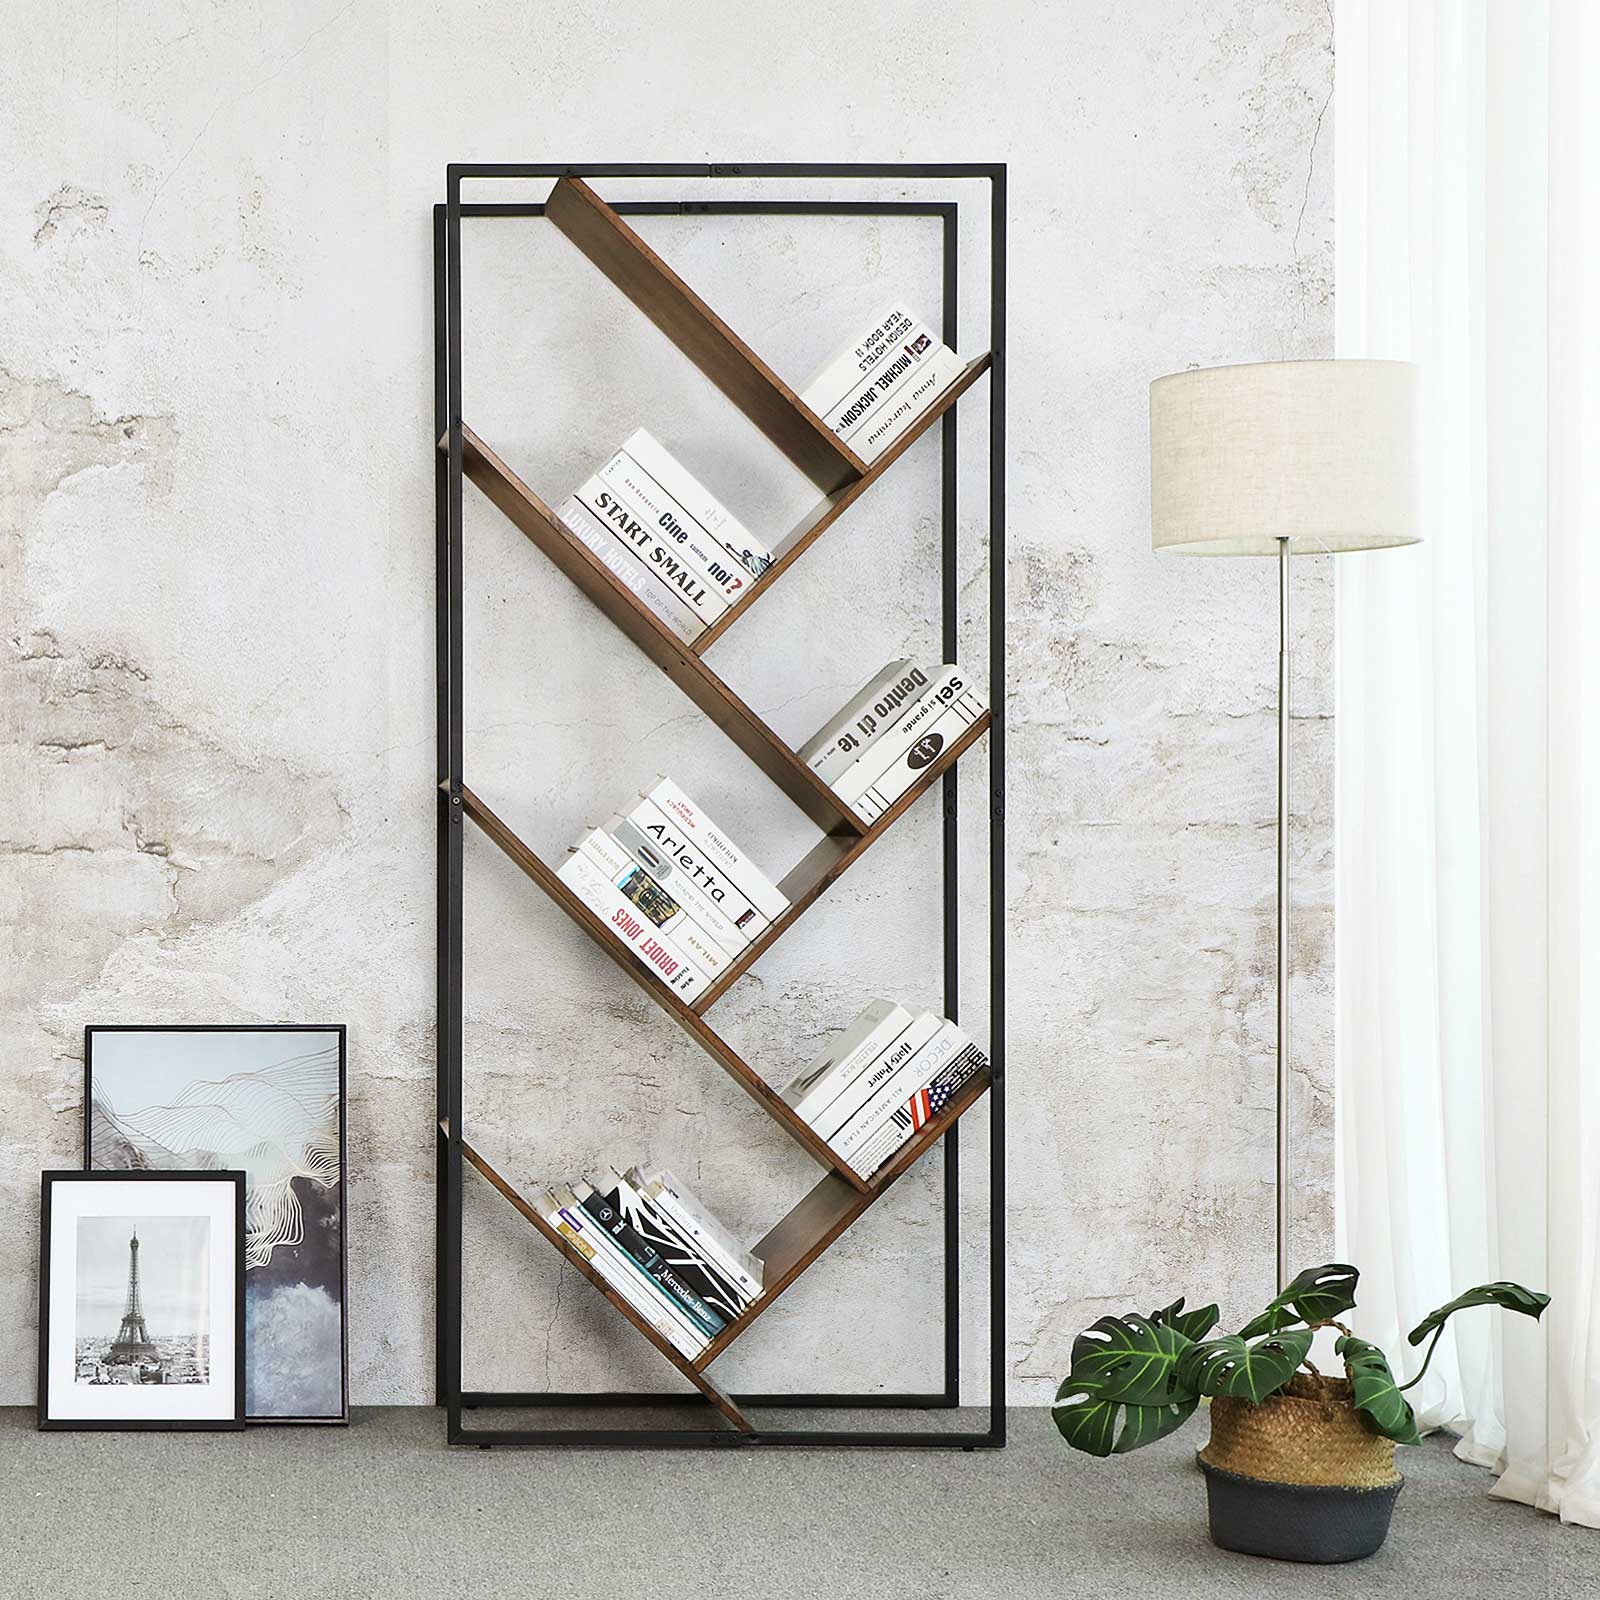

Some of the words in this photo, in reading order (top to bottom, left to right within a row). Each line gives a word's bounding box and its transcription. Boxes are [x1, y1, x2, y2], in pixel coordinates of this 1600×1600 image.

[882, 311, 903, 331] YEAR
[885, 318, 913, 345] DESIGN
[862, 328, 884, 351] BOOK
[858, 342, 888, 372] HOTELS
[874, 354, 912, 391] MICHAEL
[912, 373, 935, 400] Anna
[841, 387, 878, 427] JACKSON
[594, 493, 653, 547] START
[649, 547, 706, 607] SMALL
[658, 512, 688, 544] Cine
[707, 562, 743, 594] noi?
[563, 508, 609, 551] LUXURY
[602, 547, 648, 591] HOTELS
[645, 588, 656, 600] TOP
[654, 598, 664, 607] OF
[662, 605, 673, 618] THE
[672, 616, 694, 637] WORLD
[874, 667, 928, 718] Dentro
[927, 699, 936, 710] si
[934, 676, 963, 708] sei
[856, 714, 877, 738] di
[902, 706, 929, 733] grande
[837, 733, 860, 752] te
[647, 825, 725, 903] Arletta
[611, 908, 644, 941] JONES
[688, 936, 718, 966] MILAN
[890, 1042, 912, 1065] Harry
[912, 1038, 952, 1078] DECOR
[868, 1061, 894, 1088] Potter
[660, 1270, 712, 1321] Mercedes-Benz
